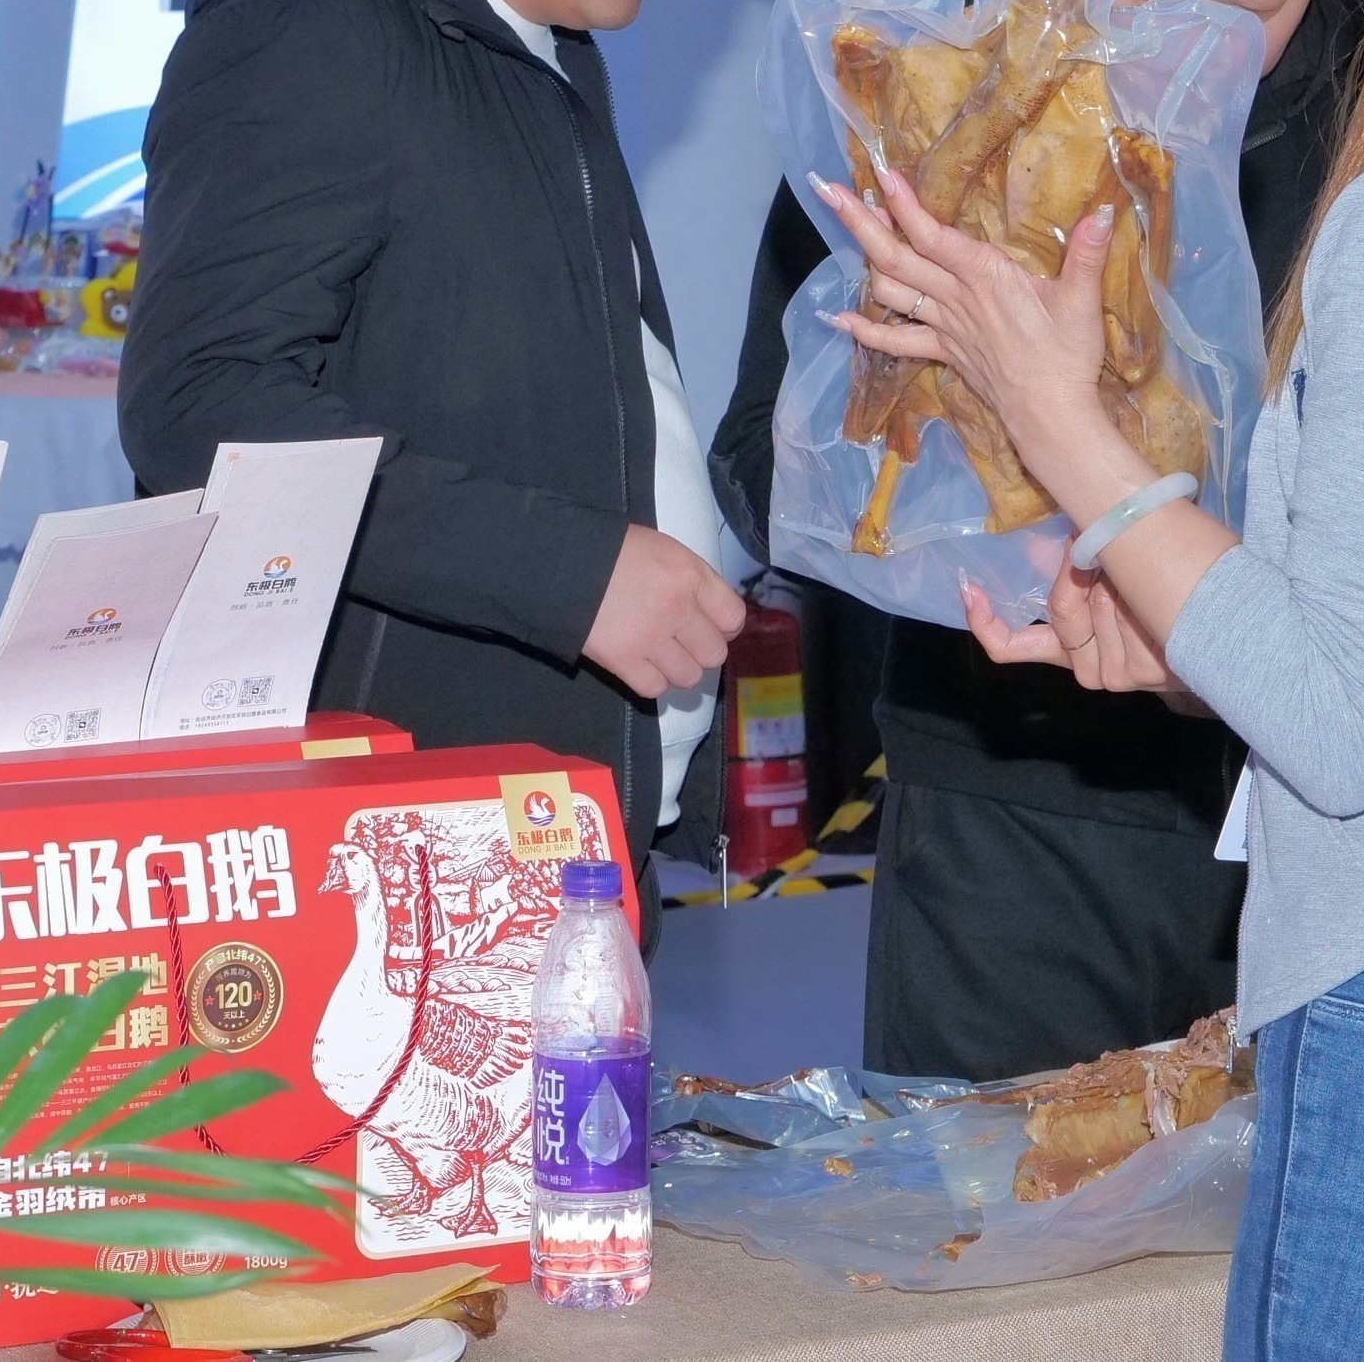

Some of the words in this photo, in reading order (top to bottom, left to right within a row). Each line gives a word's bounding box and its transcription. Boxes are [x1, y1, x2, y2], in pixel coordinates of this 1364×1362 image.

[246, 577, 297, 592] 东极白鹅
[243, 590, 265, 598] DONG
[516, 828, 574, 846] 东极白鹅
[517, 845, 542, 855] DONG
[554, 843, 567, 851] BAI
[570, 842, 576, 850] E
[215, 981, 253, 1009] 120
[223, 1010, 246, 1020] 天以上
[537, 1067, 565, 1166] 纯悦
[110, 1194, 147, 1207] 核心产区
[244, 1255, 288, 1269] 1800g
